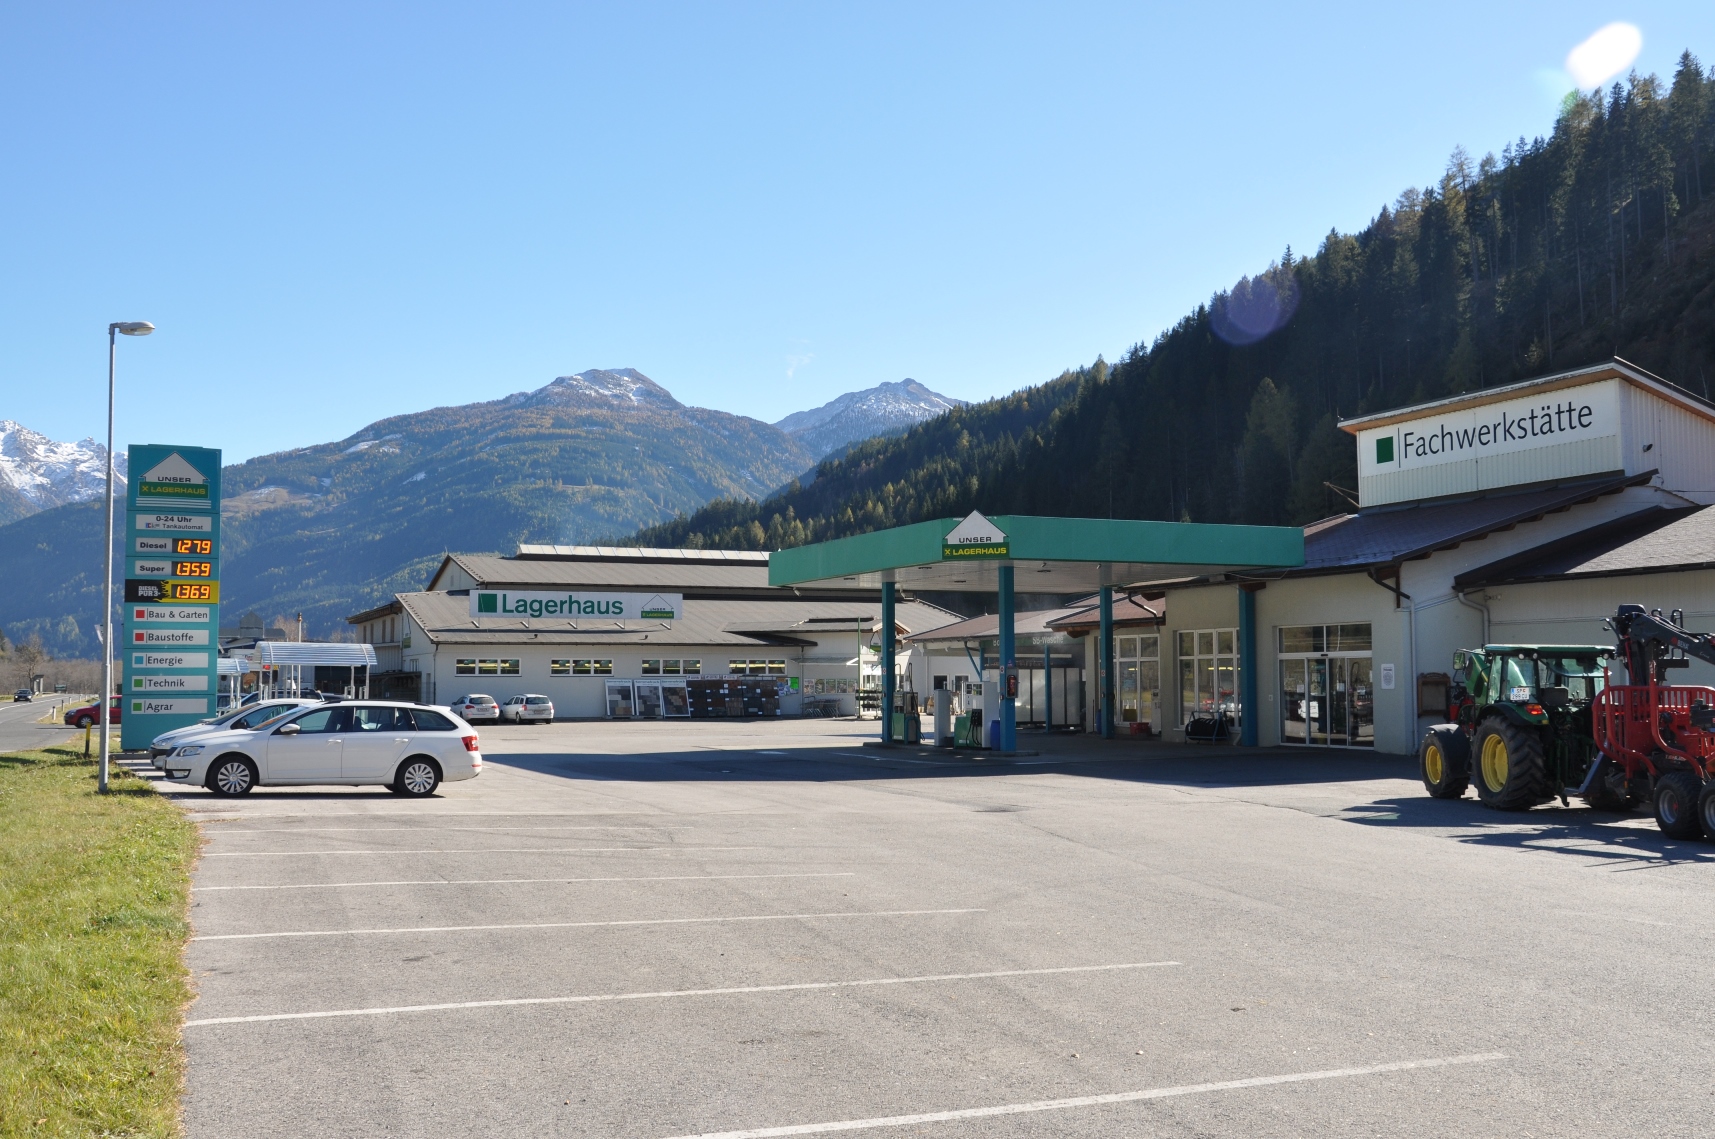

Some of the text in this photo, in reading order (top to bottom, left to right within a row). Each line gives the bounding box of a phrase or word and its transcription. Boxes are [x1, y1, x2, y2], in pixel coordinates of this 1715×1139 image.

[1403, 401, 1593, 459] Fachwerkstätte
[150, 486, 206, 495] LAGERHAUS
[139, 541, 167, 549] Diesel
[952, 547, 1007, 556] LAGERHAUS
[139, 565, 165, 573] Super
[502, 593, 624, 618] Lagerhaus
[148, 610, 166, 618] Bau
[178, 610, 208, 619] Garten
[148, 632, 194, 641] Baustoffe
[147, 656, 183, 667] Energie
[147, 679, 185, 687] Technik
[146, 702, 174, 713] Agrar
